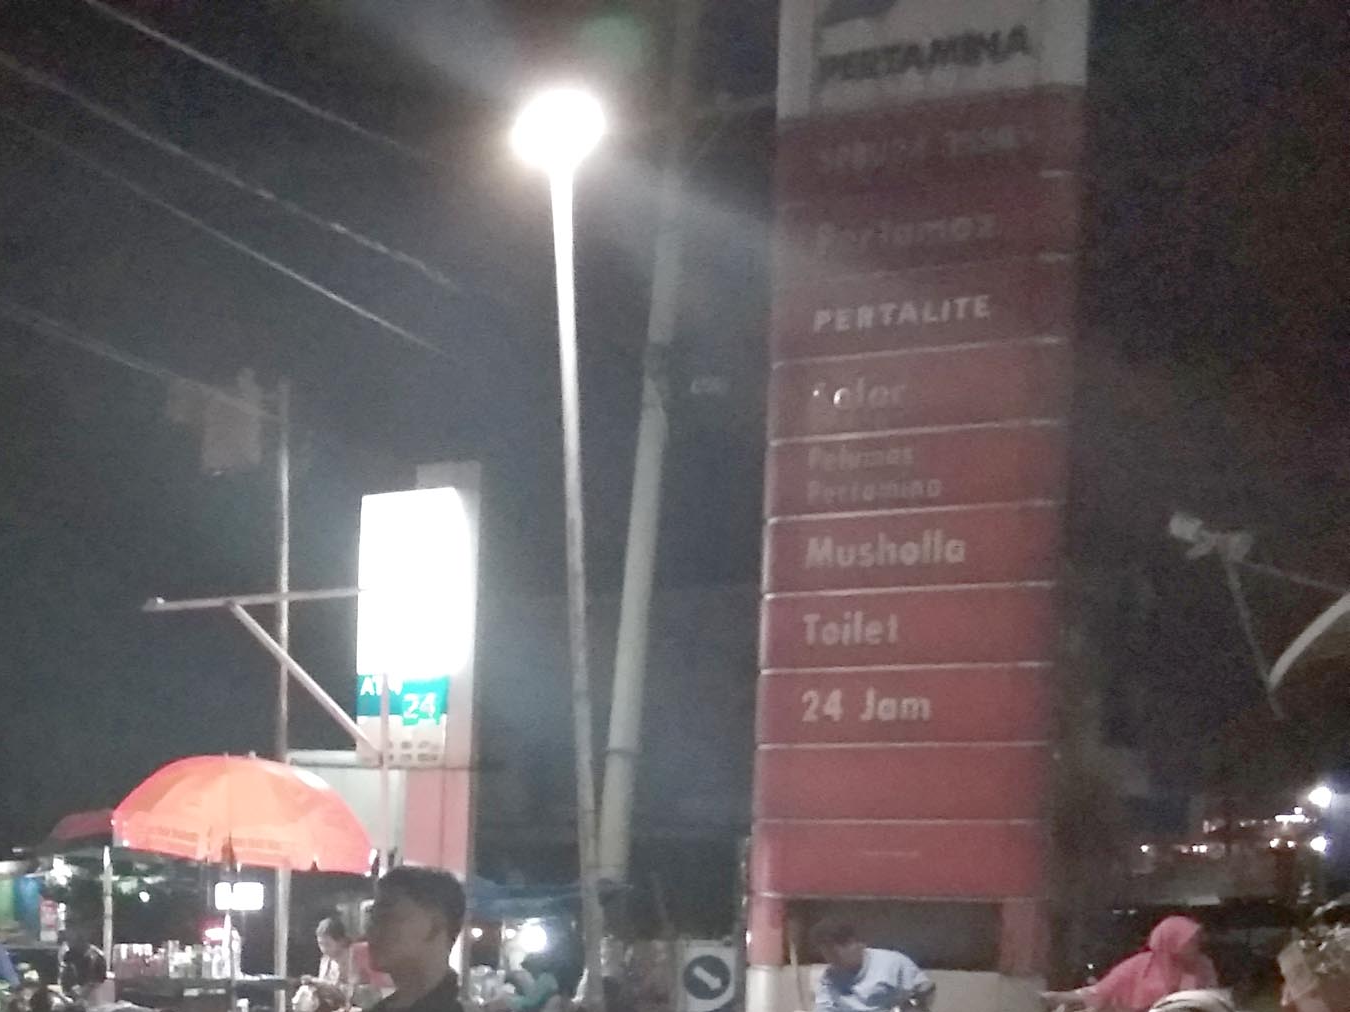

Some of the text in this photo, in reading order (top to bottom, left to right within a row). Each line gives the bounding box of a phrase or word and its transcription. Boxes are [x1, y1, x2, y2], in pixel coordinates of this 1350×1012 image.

[812, 294, 992, 332] PERTALITE
[805, 529, 967, 570] Musholla
[803, 613, 900, 646] Toilet
[402, 692, 437, 719] 24
[801, 687, 932, 722] 24 Jam
